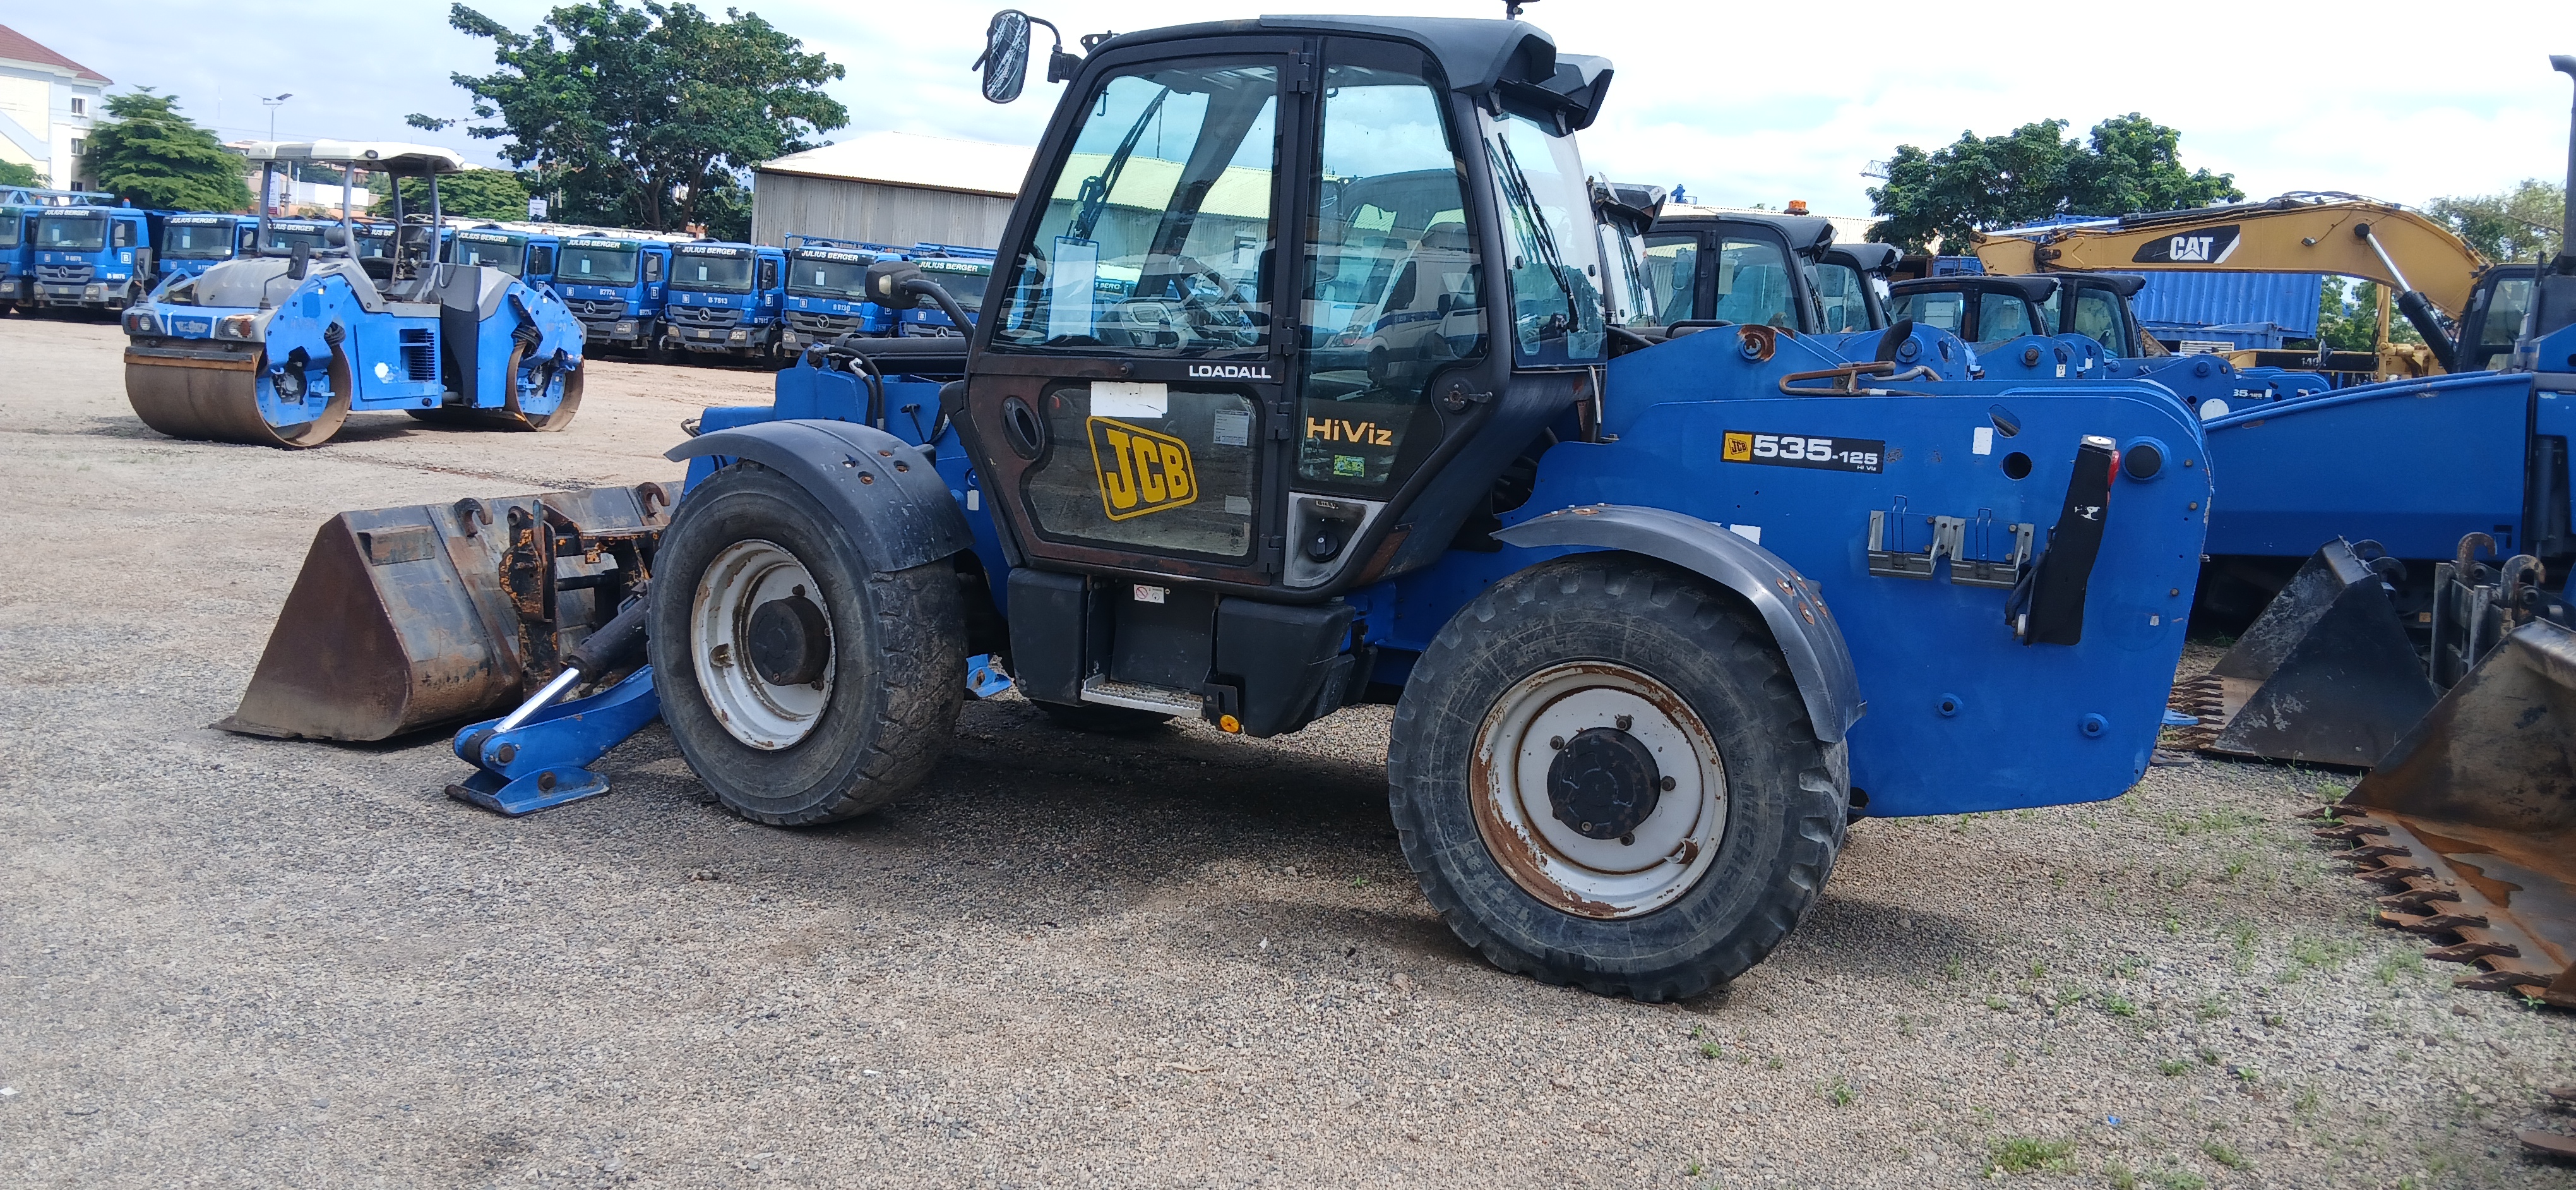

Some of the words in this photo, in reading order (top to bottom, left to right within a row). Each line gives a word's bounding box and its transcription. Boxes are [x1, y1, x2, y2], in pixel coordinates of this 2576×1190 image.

[458, 232, 480, 240] JULIUS
[480, 234, 508, 243] BERGER
[591, 241, 621, 249] BERGER
[2169, 236, 2214, 261] CAT
[707, 247, 737, 256] BERGER
[801, 250, 826, 258] JULIUS
[828, 252, 859, 261] BERGER
[946, 263, 978, 272] BERGER
[1189, 365, 1272, 379] LOADALL
[1306, 417, 1392, 446] HiViz
[1731, 440, 1748, 454] JCB
[1753, 435, 1878, 465] 535-125
[1106, 428, 1190, 510] JCB
